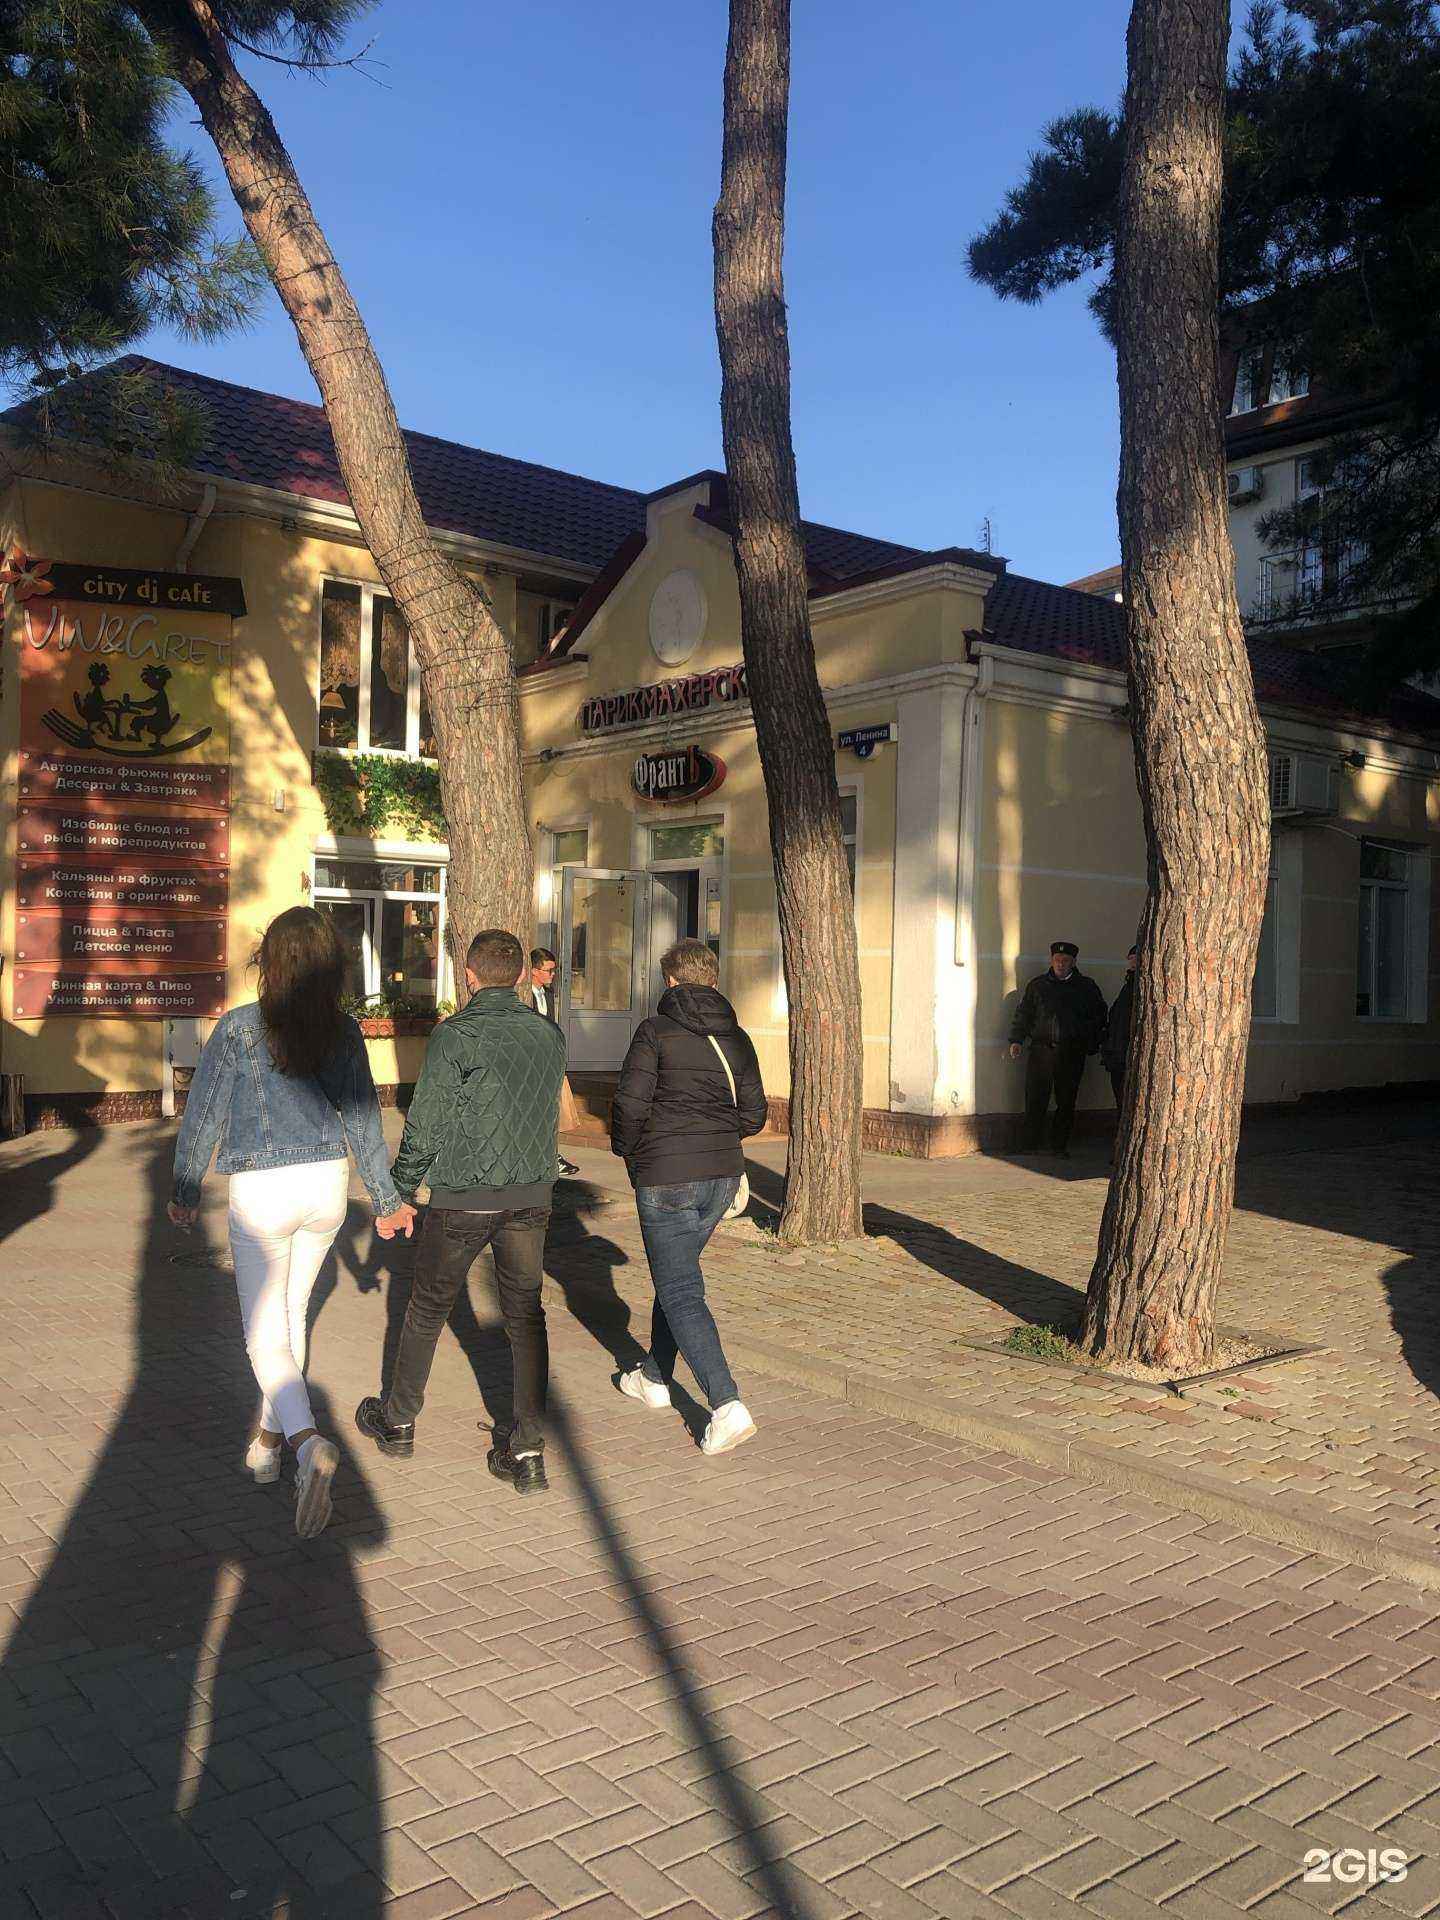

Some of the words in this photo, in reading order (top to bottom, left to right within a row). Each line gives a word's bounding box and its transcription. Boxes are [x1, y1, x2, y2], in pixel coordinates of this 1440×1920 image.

[580, 665, 746, 730] ПАРИКМАХЕРСК
[856, 729, 888, 742] Ленина
[40, 761, 113, 776] Авторская
[118, 767, 168, 779] фьюжн
[173, 771, 212, 783] кухня
[56, 778, 116, 792] Десерты
[120, 782, 130, 791] &
[134, 783, 198, 796] Завтраки
[62, 818, 130, 832] Изобилие
[134, 822, 170, 835] блюд
[175, 826, 190, 835] из
[44, 833, 84, 845] рыбы
[88, 836, 97, 845] и
[101, 836, 206, 850] морепродуктов
[51, 870, 114, 883] Кальяны
[118, 875, 135, 884] на
[139, 874, 196, 886] фруктах
[46, 887, 113, 900] Коктейли
[117, 892, 125, 900] в
[129, 892, 200, 903] оригинале
[72, 925, 117, 938] Пицца
[122, 927, 132, 937] &
[136, 926, 175, 938] Паста
[74, 940, 130, 953] Детское
[134, 943, 173, 953] меню
[51, 980, 102, 991] Винная
[105, 982, 142, 993] карта
[146, 981, 156, 991] &
[159, 980, 192, 991] Пиво
[47, 993, 133, 1006] Уникальный
[135, 996, 195, 1008] интерьер
